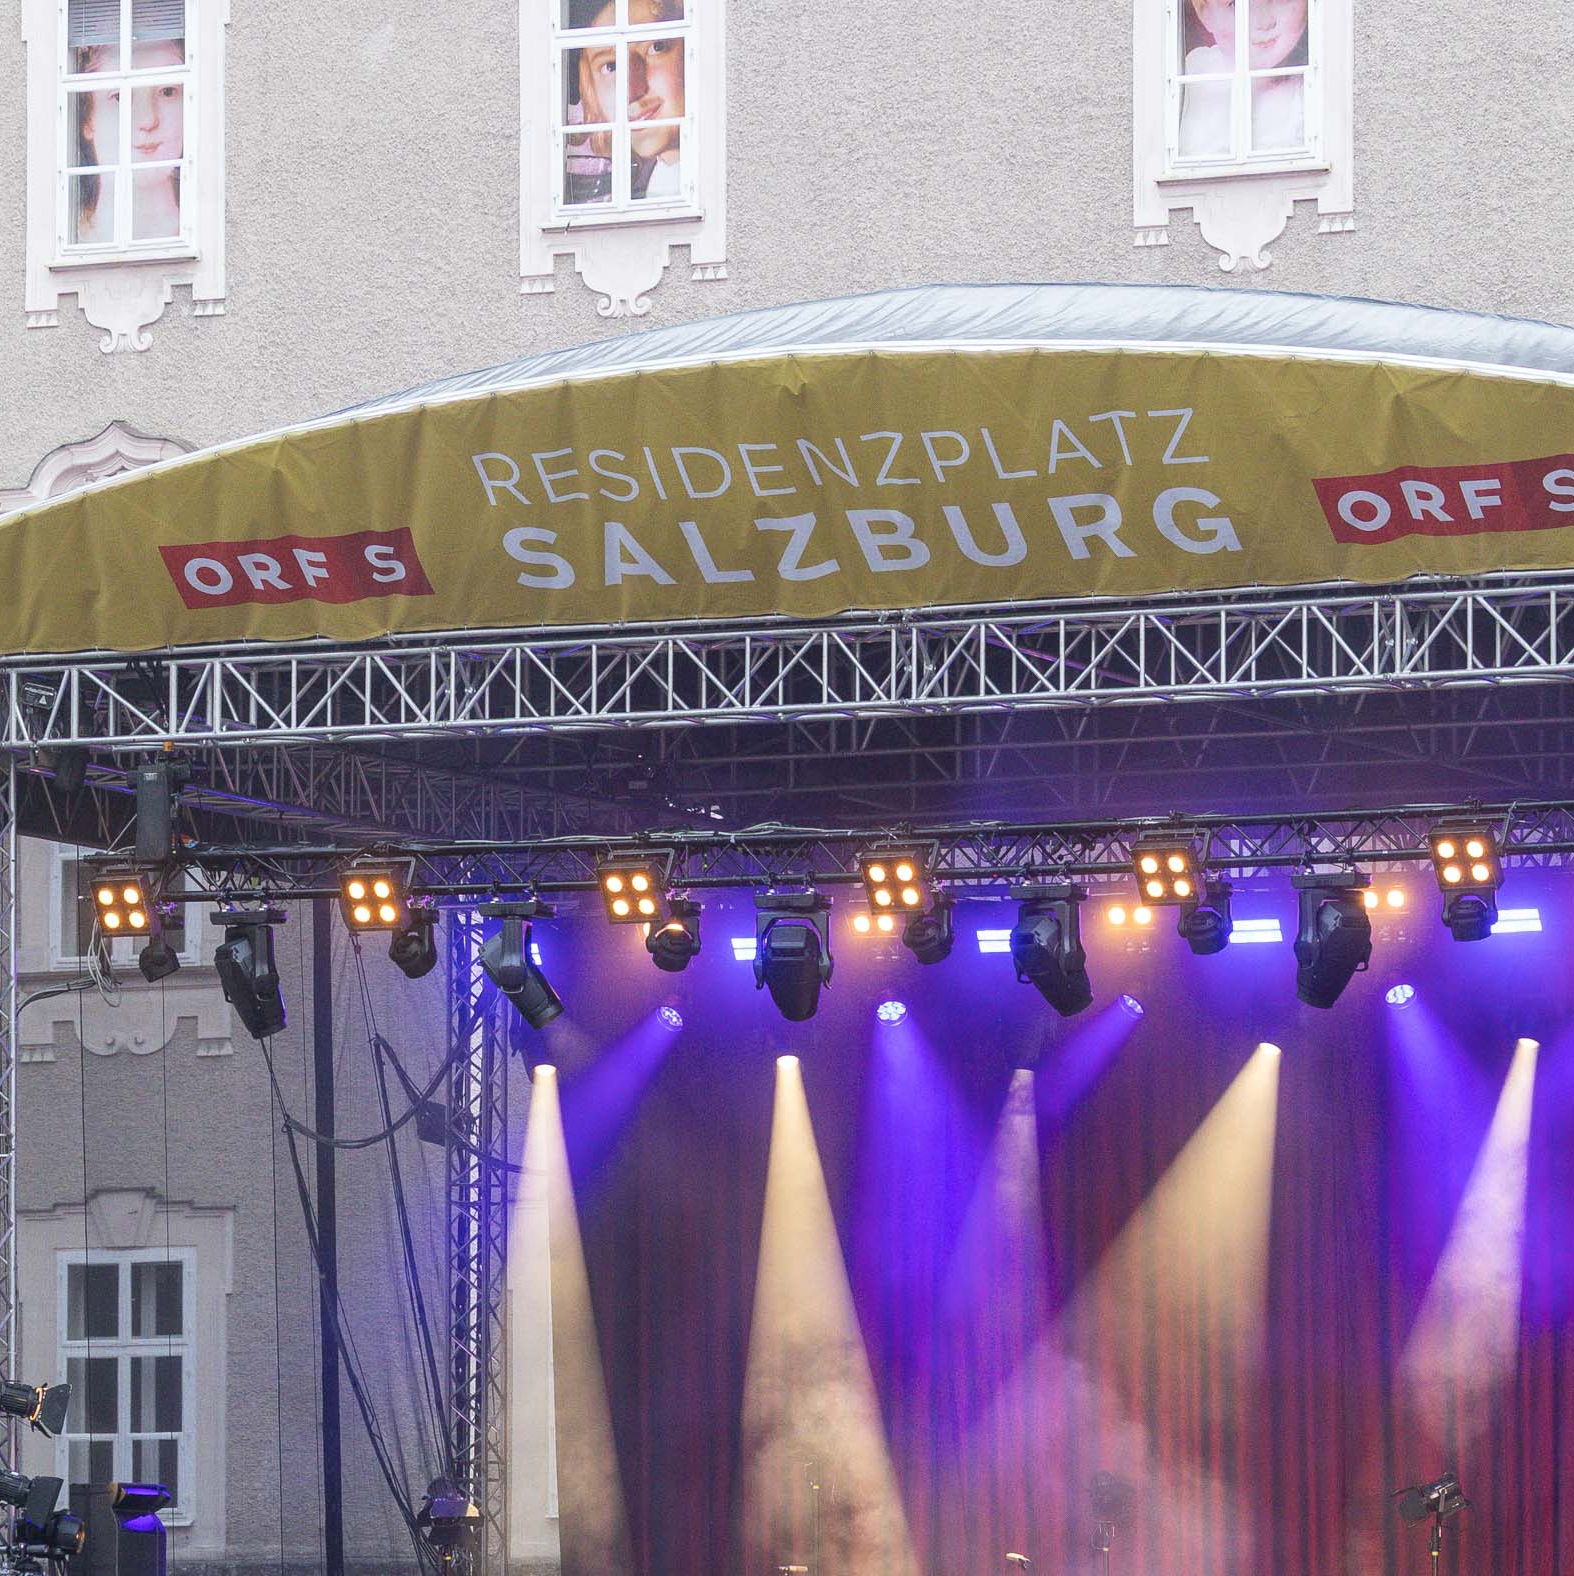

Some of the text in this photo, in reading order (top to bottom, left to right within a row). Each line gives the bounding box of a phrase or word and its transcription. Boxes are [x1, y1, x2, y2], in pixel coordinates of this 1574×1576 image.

[472, 407, 1210, 506] RESIDENZPLATZ
[502, 486, 1243, 590] SALZBURG
[1337, 478, 1502, 532] ORF
[184, 544, 406, 595] ORF S
